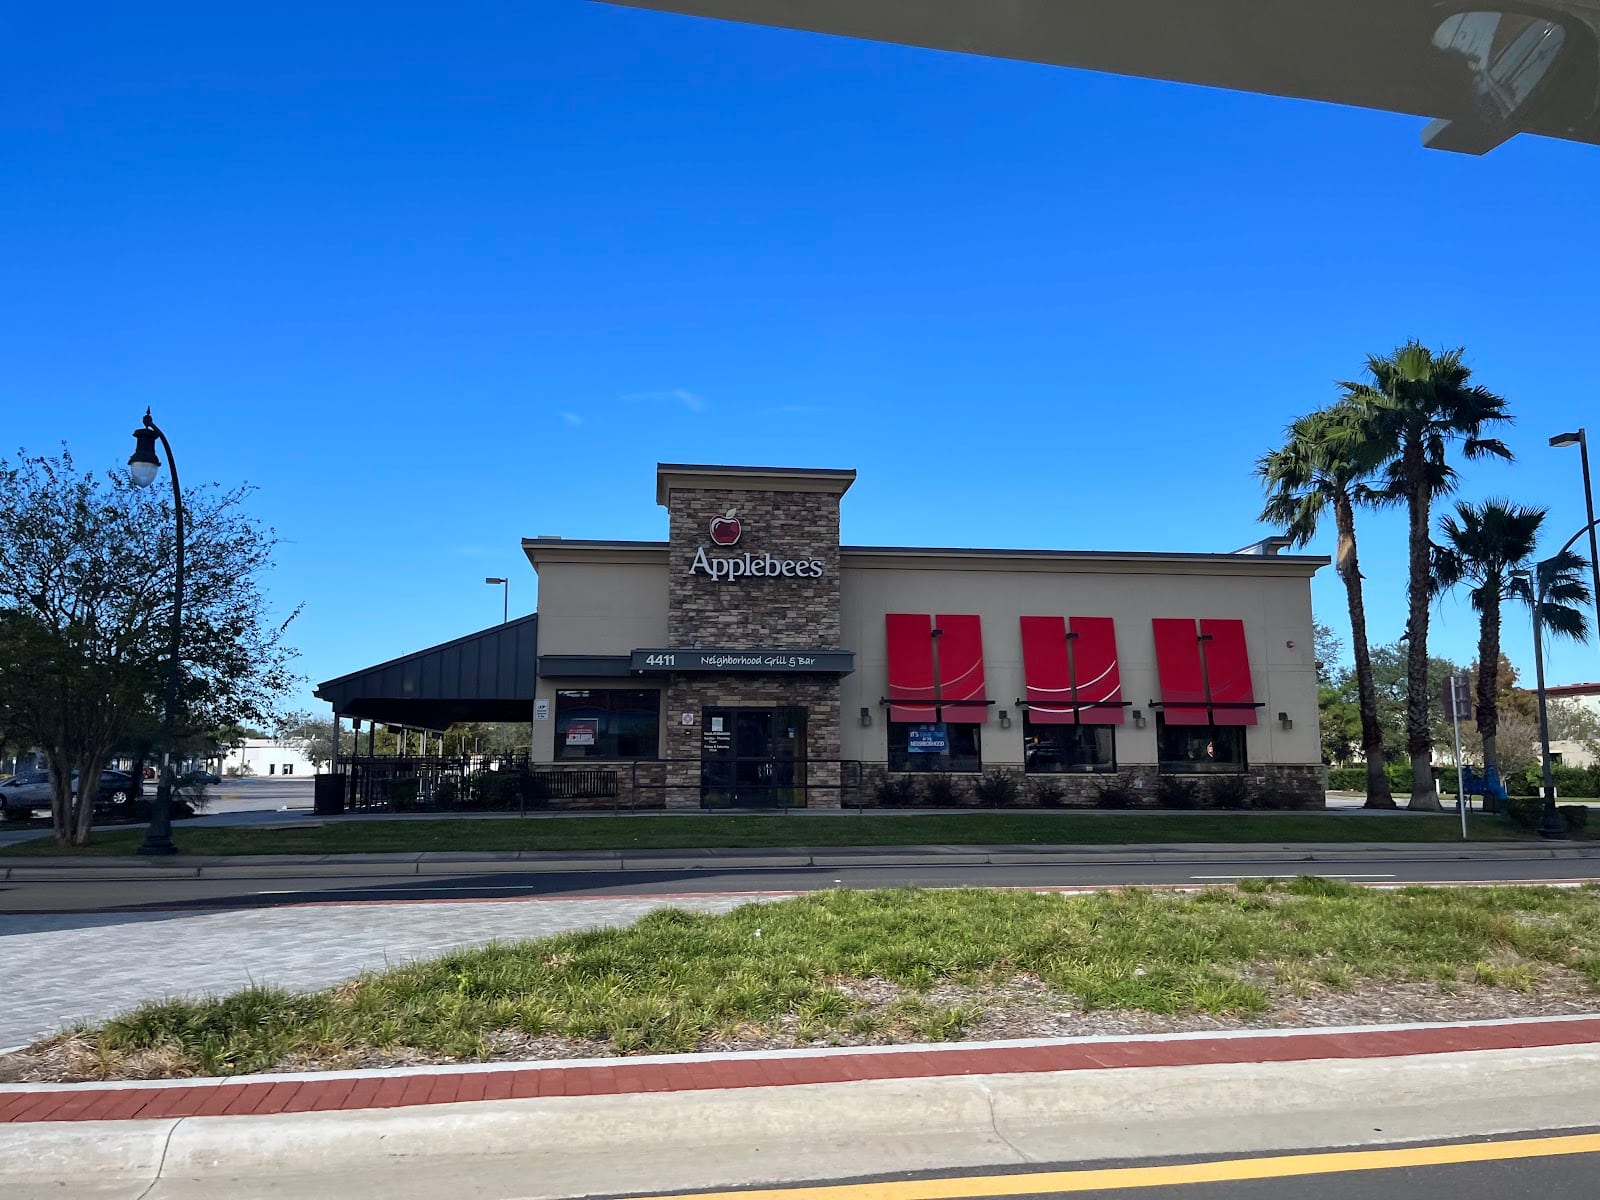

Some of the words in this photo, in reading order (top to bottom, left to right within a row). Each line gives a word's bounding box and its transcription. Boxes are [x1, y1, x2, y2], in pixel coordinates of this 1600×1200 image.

[688, 546, 823, 581] Applebee's
[645, 654, 676, 666] 4411
[701, 655, 762, 667] Neighborhood
[764, 656, 788, 666] Grill
[788, 656, 796, 667] &
[797, 656, 816, 666] Bar
